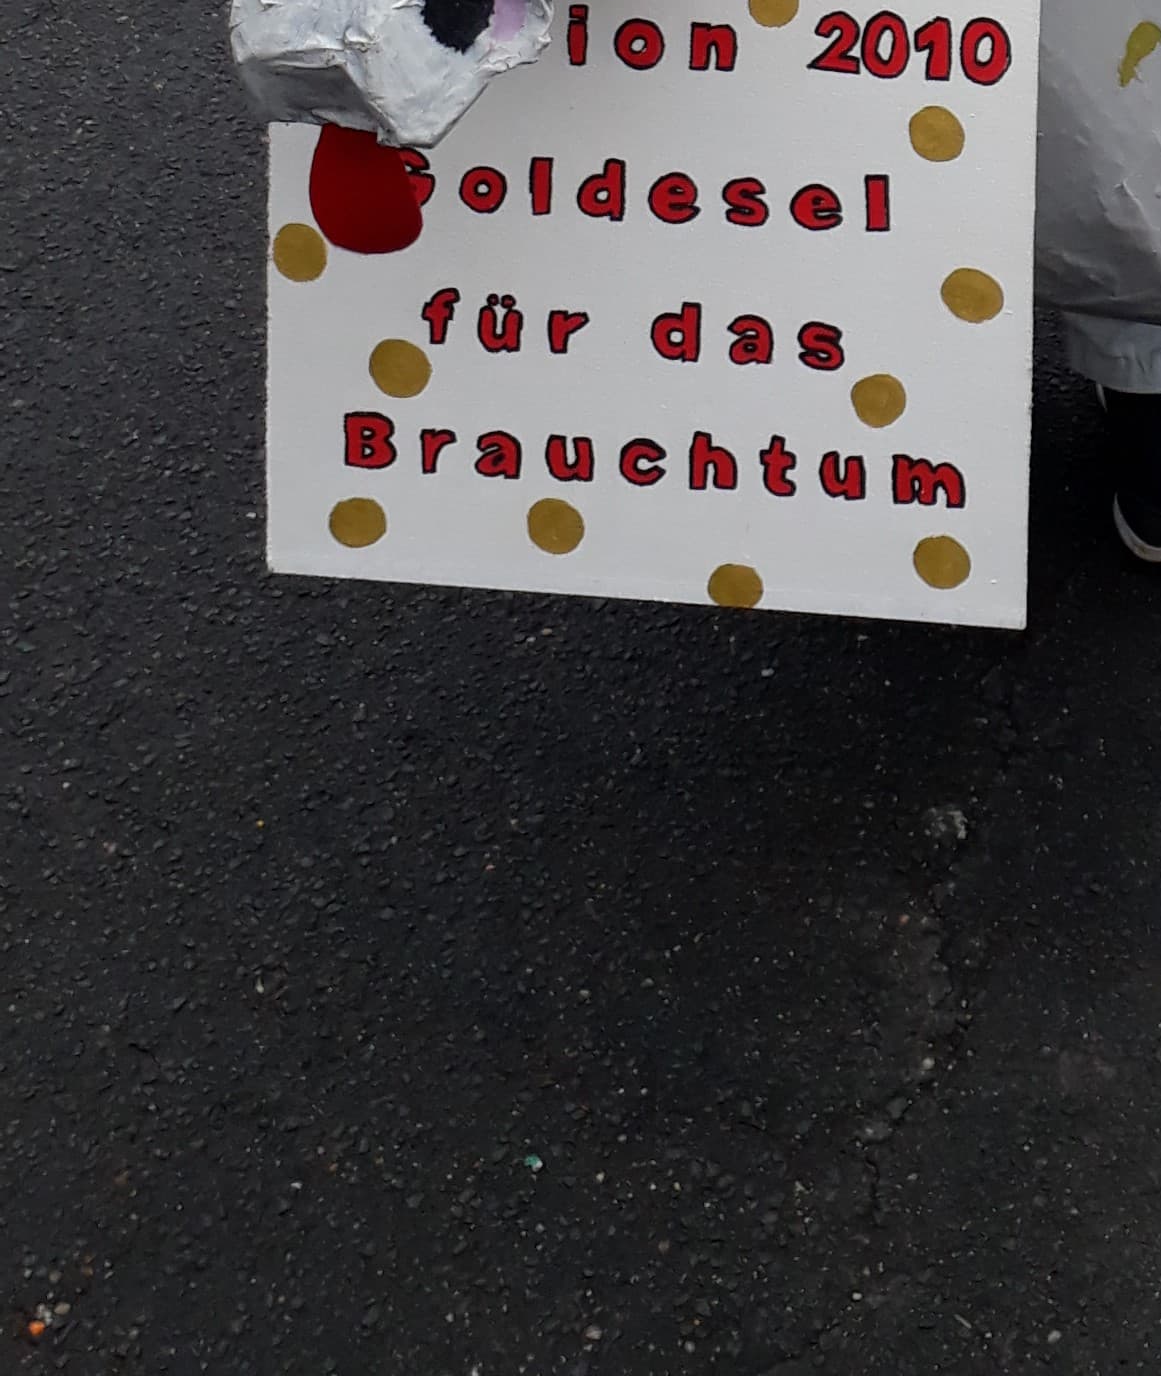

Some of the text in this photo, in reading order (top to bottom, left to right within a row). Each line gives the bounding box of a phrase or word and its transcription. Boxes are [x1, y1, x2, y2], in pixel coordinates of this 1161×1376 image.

[566, 4, 1013, 87] ion 2010
[421, 287, 846, 371] für das
[343, 411, 967, 509] Brauchtum
